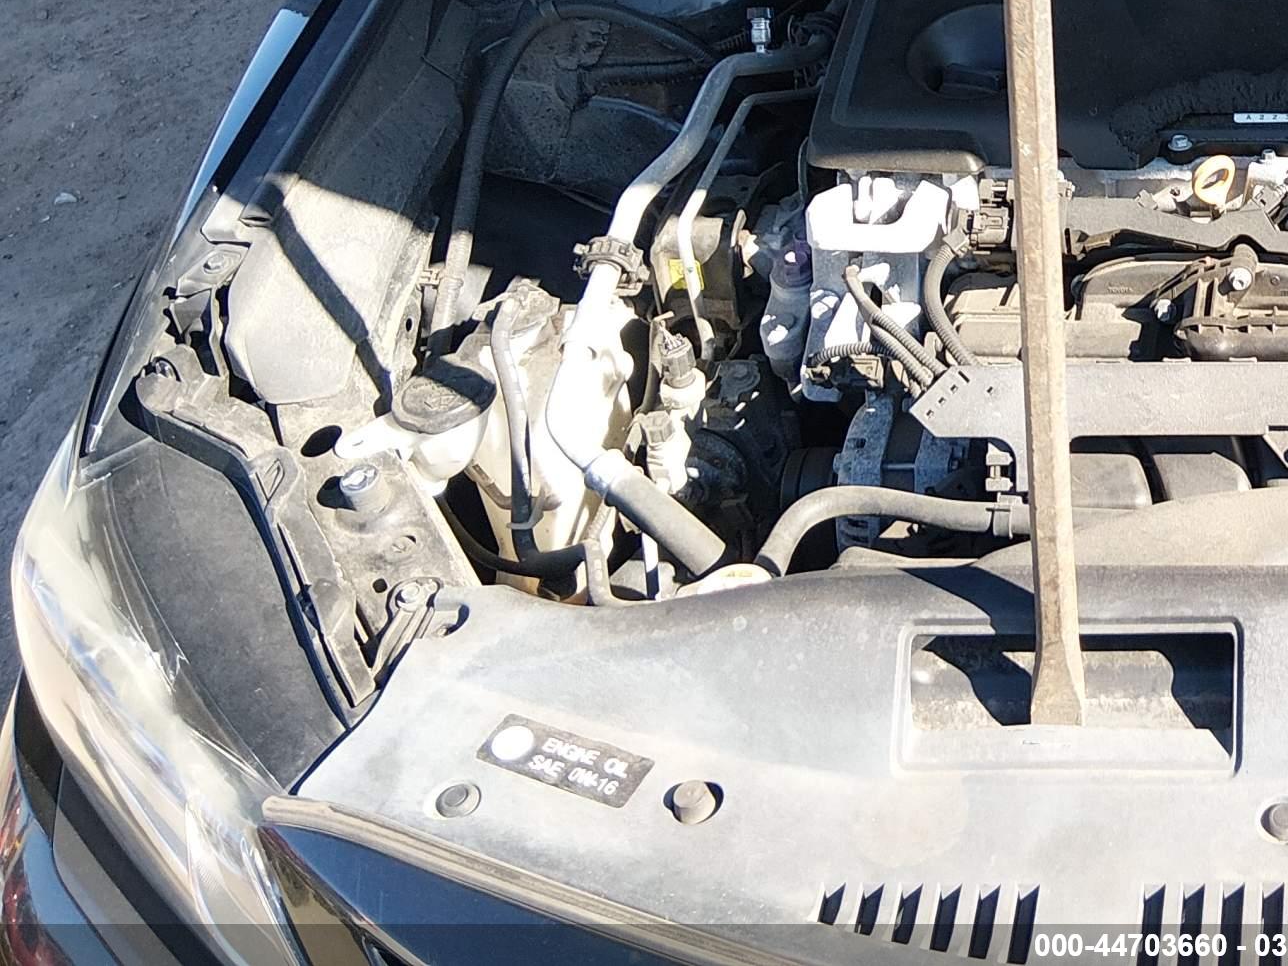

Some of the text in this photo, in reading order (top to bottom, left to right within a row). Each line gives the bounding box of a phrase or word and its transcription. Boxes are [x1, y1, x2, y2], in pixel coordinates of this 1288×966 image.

[528, 754, 620, 795] SAE 0W-16
[542, 737, 629, 779] ENGINE OIL
